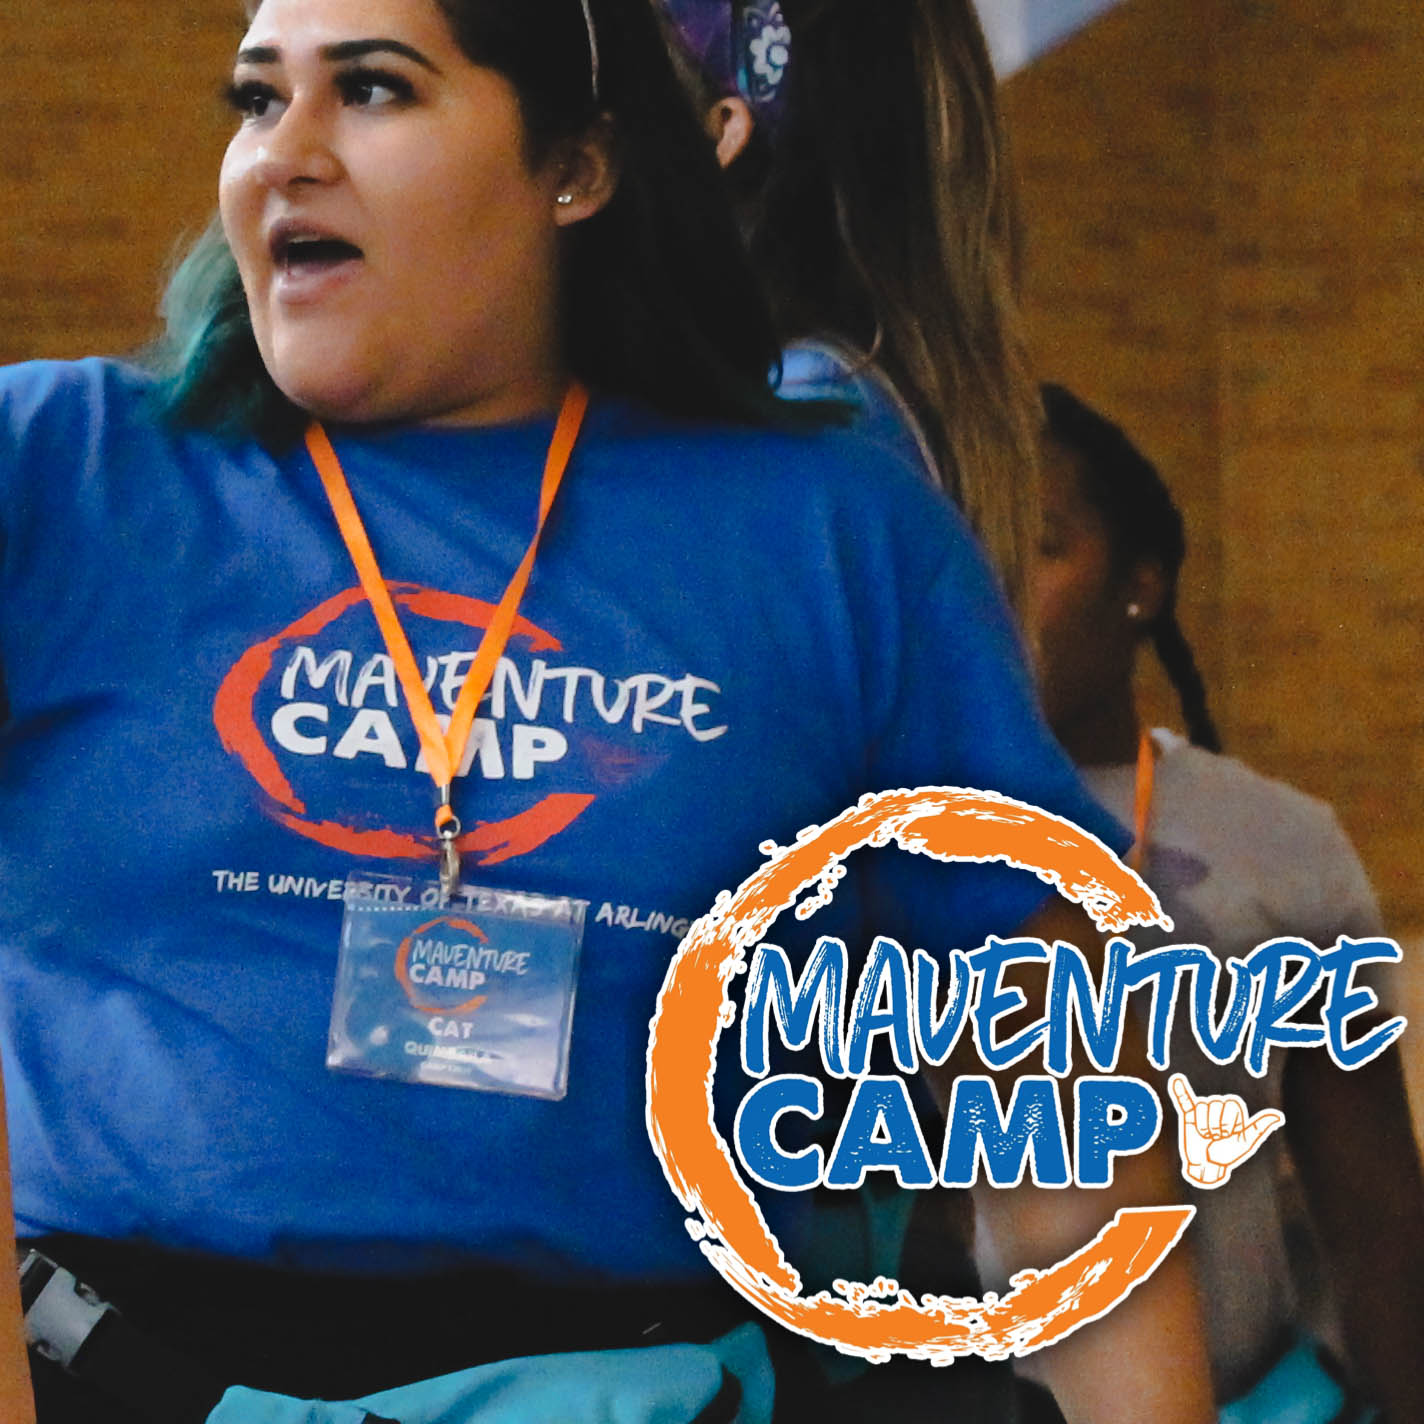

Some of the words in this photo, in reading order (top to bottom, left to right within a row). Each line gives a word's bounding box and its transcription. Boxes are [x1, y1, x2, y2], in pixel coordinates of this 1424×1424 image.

[212, 869, 260, 893] THE
[268, 874, 412, 905] UNIVERSITY
[595, 901, 694, 939] ARLING
[412, 939, 531, 976] MAVENTURE
[409, 964, 486, 990] CAMP
[427, 1017, 474, 1040] CAT
